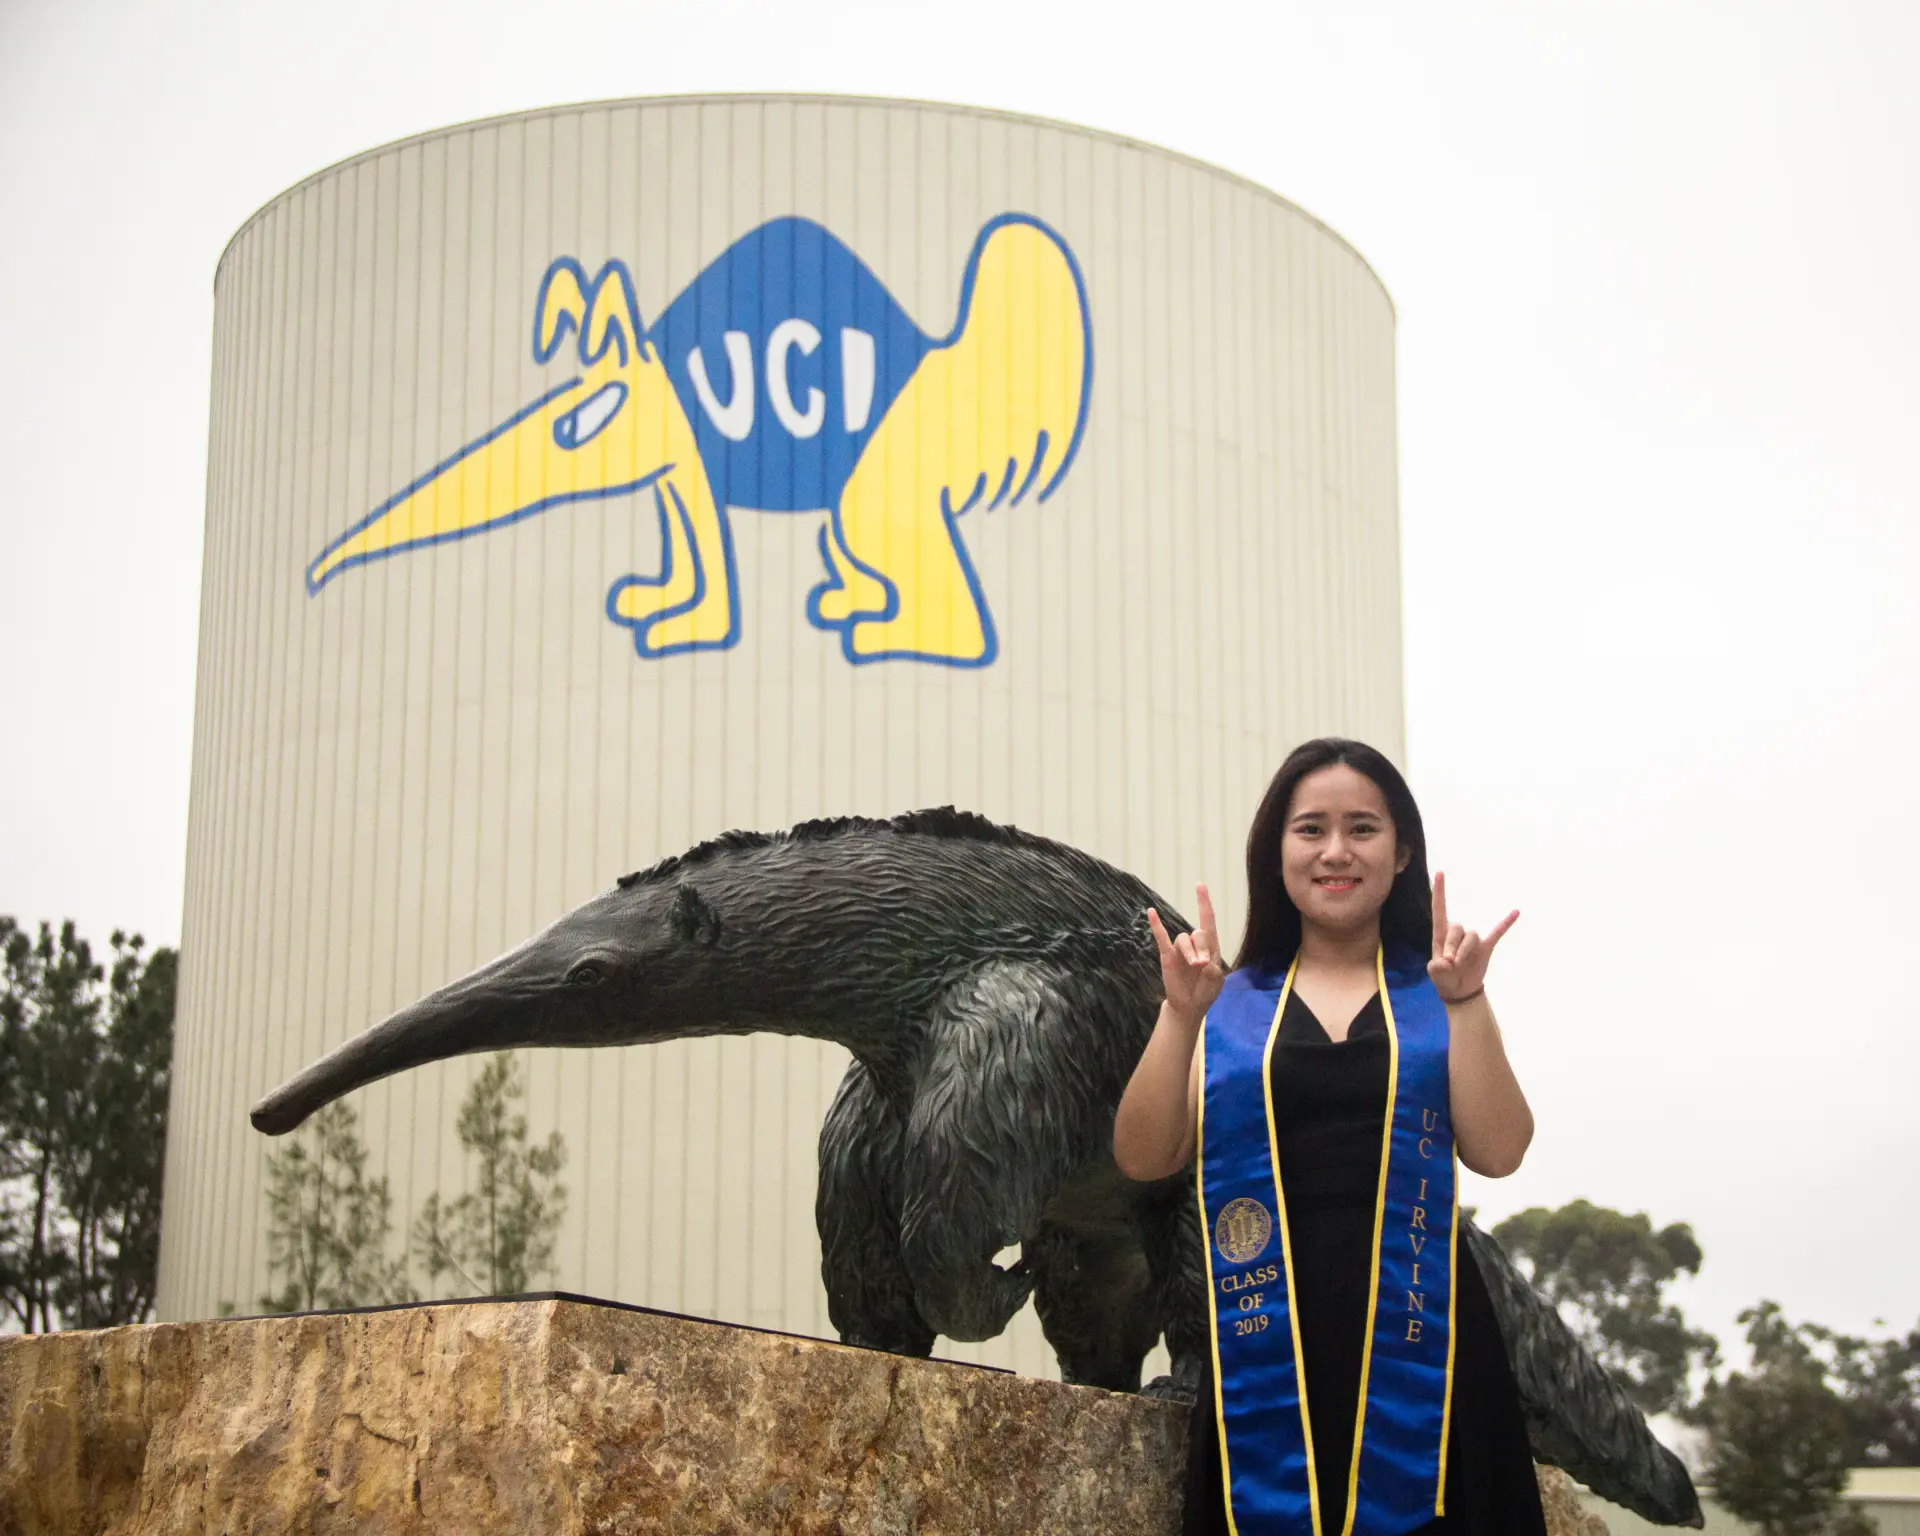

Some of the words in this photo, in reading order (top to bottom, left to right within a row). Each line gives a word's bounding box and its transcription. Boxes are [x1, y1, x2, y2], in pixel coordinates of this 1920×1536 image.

[687, 317, 876, 442] UCI
[1418, 1107, 1439, 1159] UC
[1220, 1265, 1279, 1293] CLASS
[1405, 1178, 1428, 1343] IRVINE
[1239, 1293, 1264, 1312] OF
[1235, 1314, 1269, 1336] 2019
